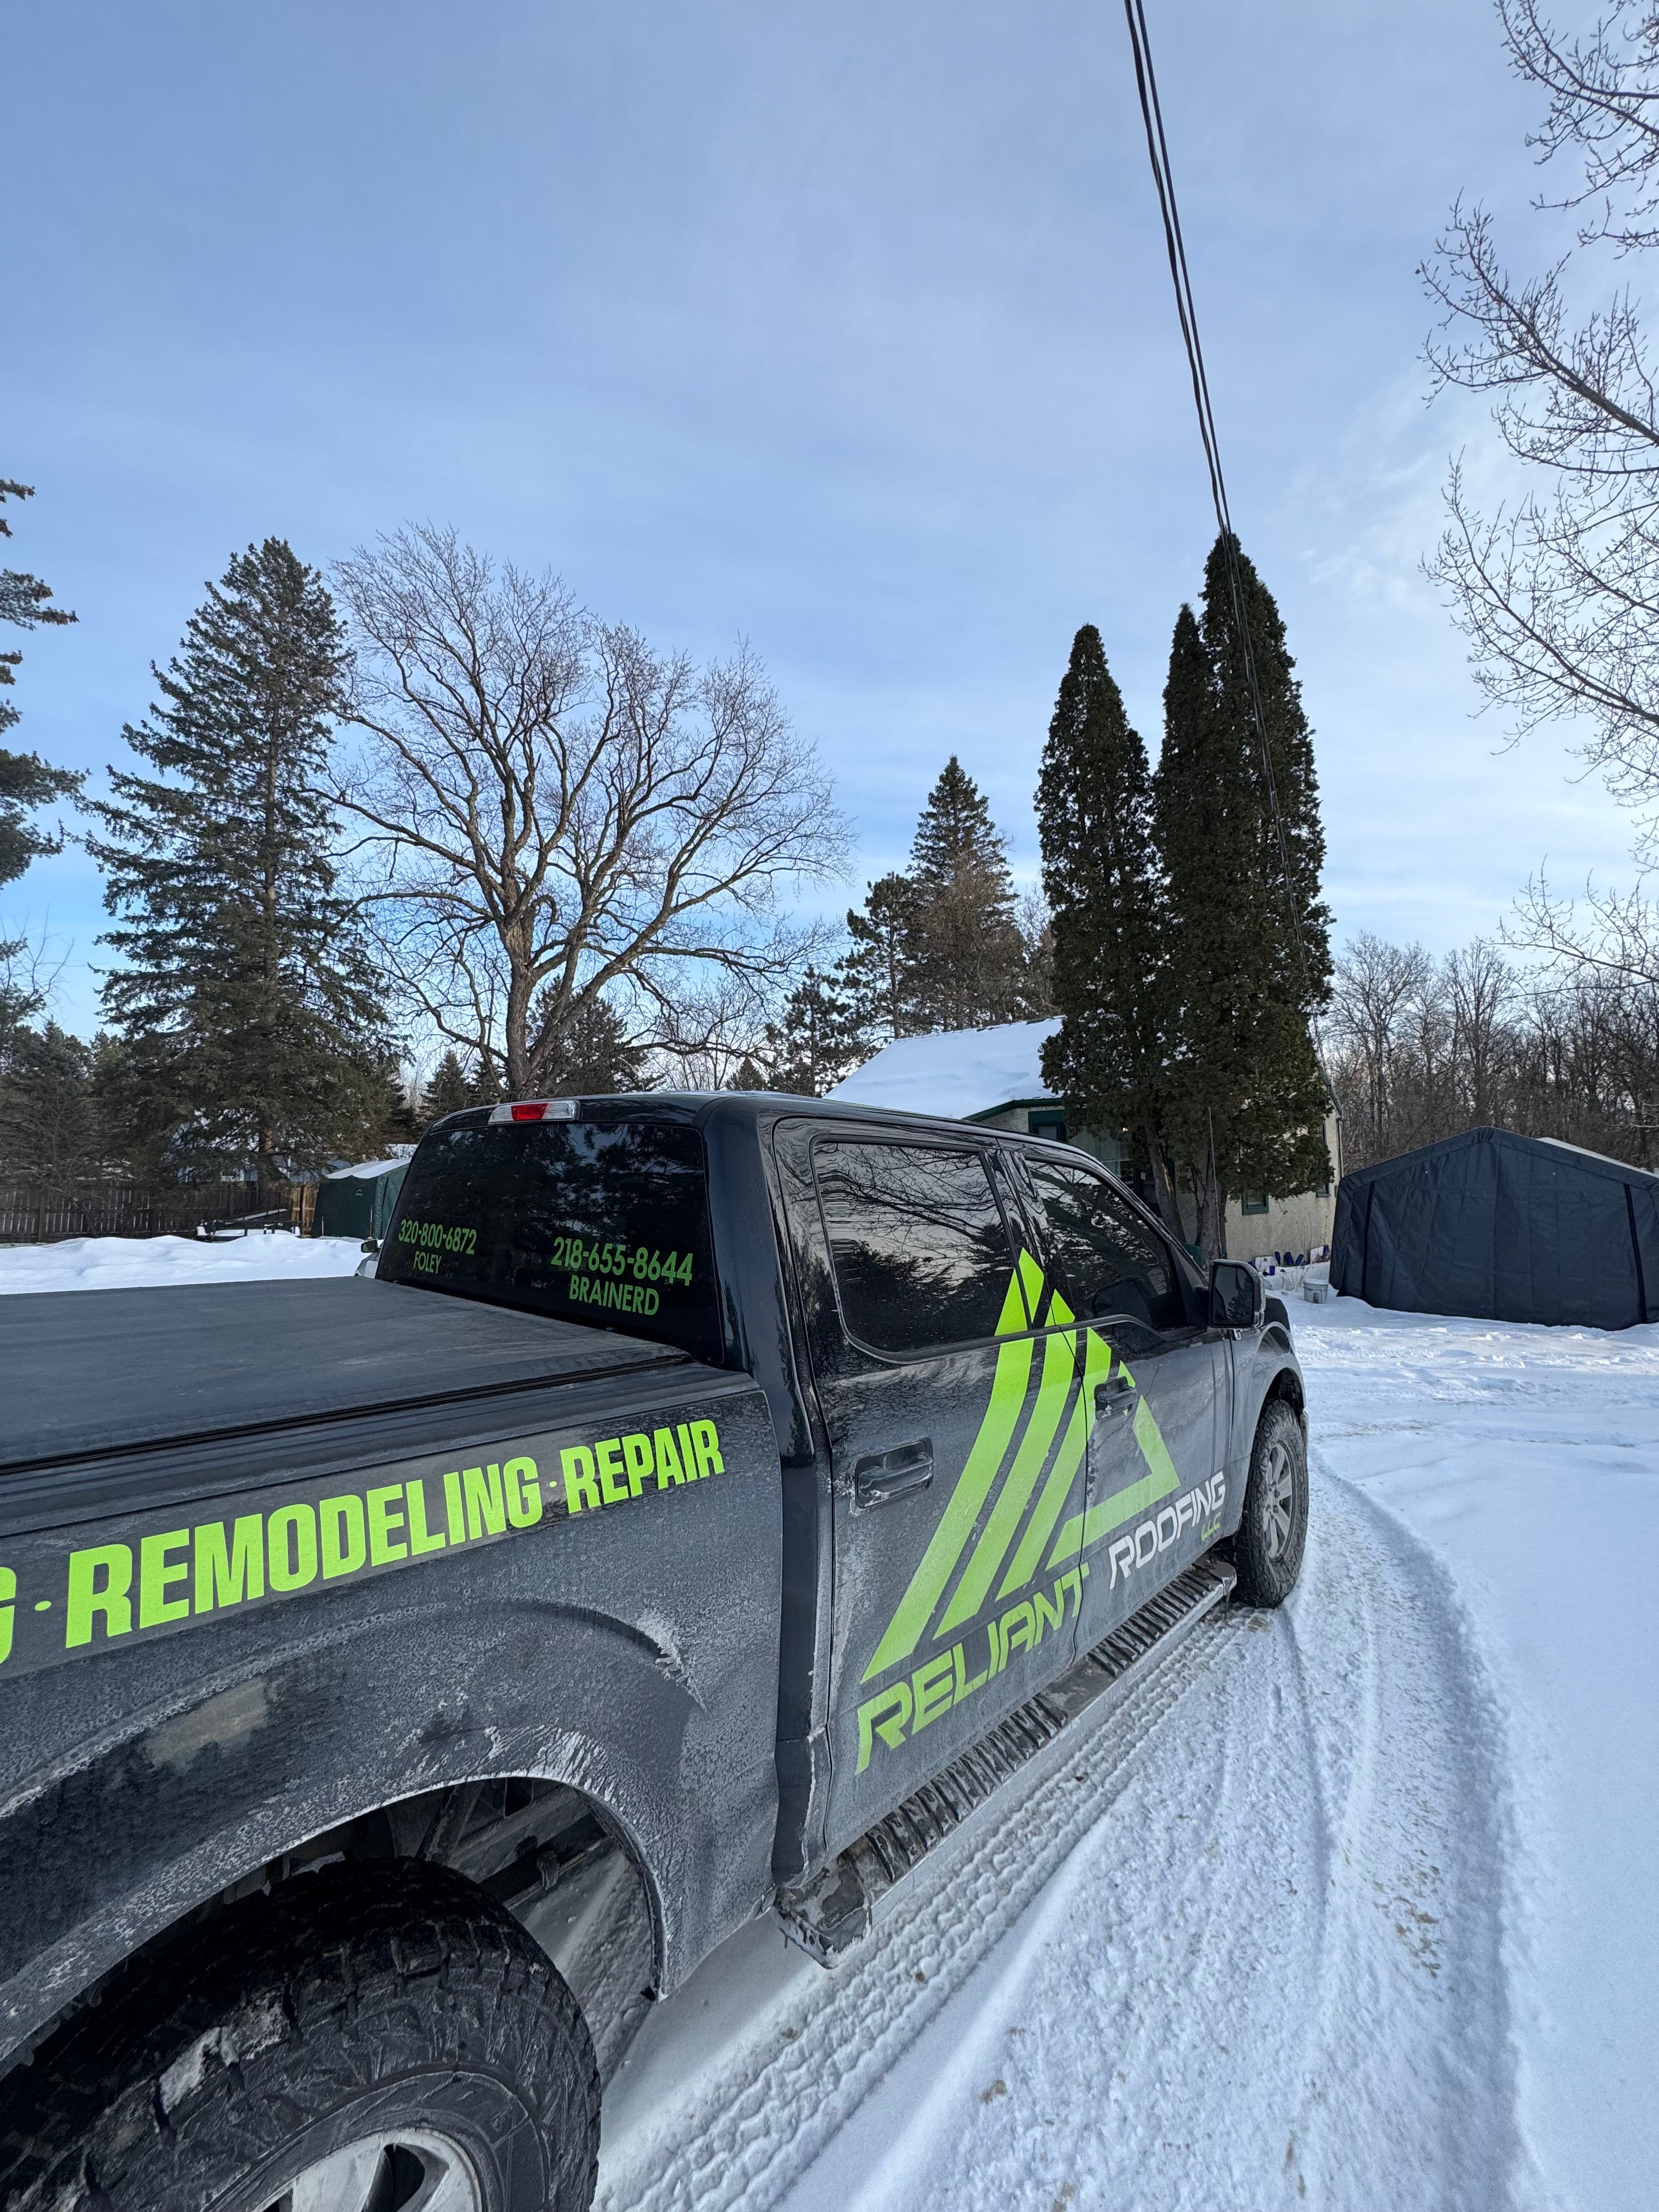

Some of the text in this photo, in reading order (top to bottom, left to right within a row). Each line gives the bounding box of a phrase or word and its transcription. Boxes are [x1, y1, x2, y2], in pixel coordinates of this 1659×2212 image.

[398, 1219, 477, 1255] 320-800-6872
[414, 1250, 442, 1274] FOLEY
[551, 1237, 693, 1286] 218-655-8644
[569, 1274, 659, 1315] BRAINERD
[65, 1457, 543, 1649] REMODELING
[560, 1419, 725, 1513] REPAIR
[1201, 1511, 1221, 1542] LLC
[856, 1471, 1226, 1774] RELIANT ROOFING
